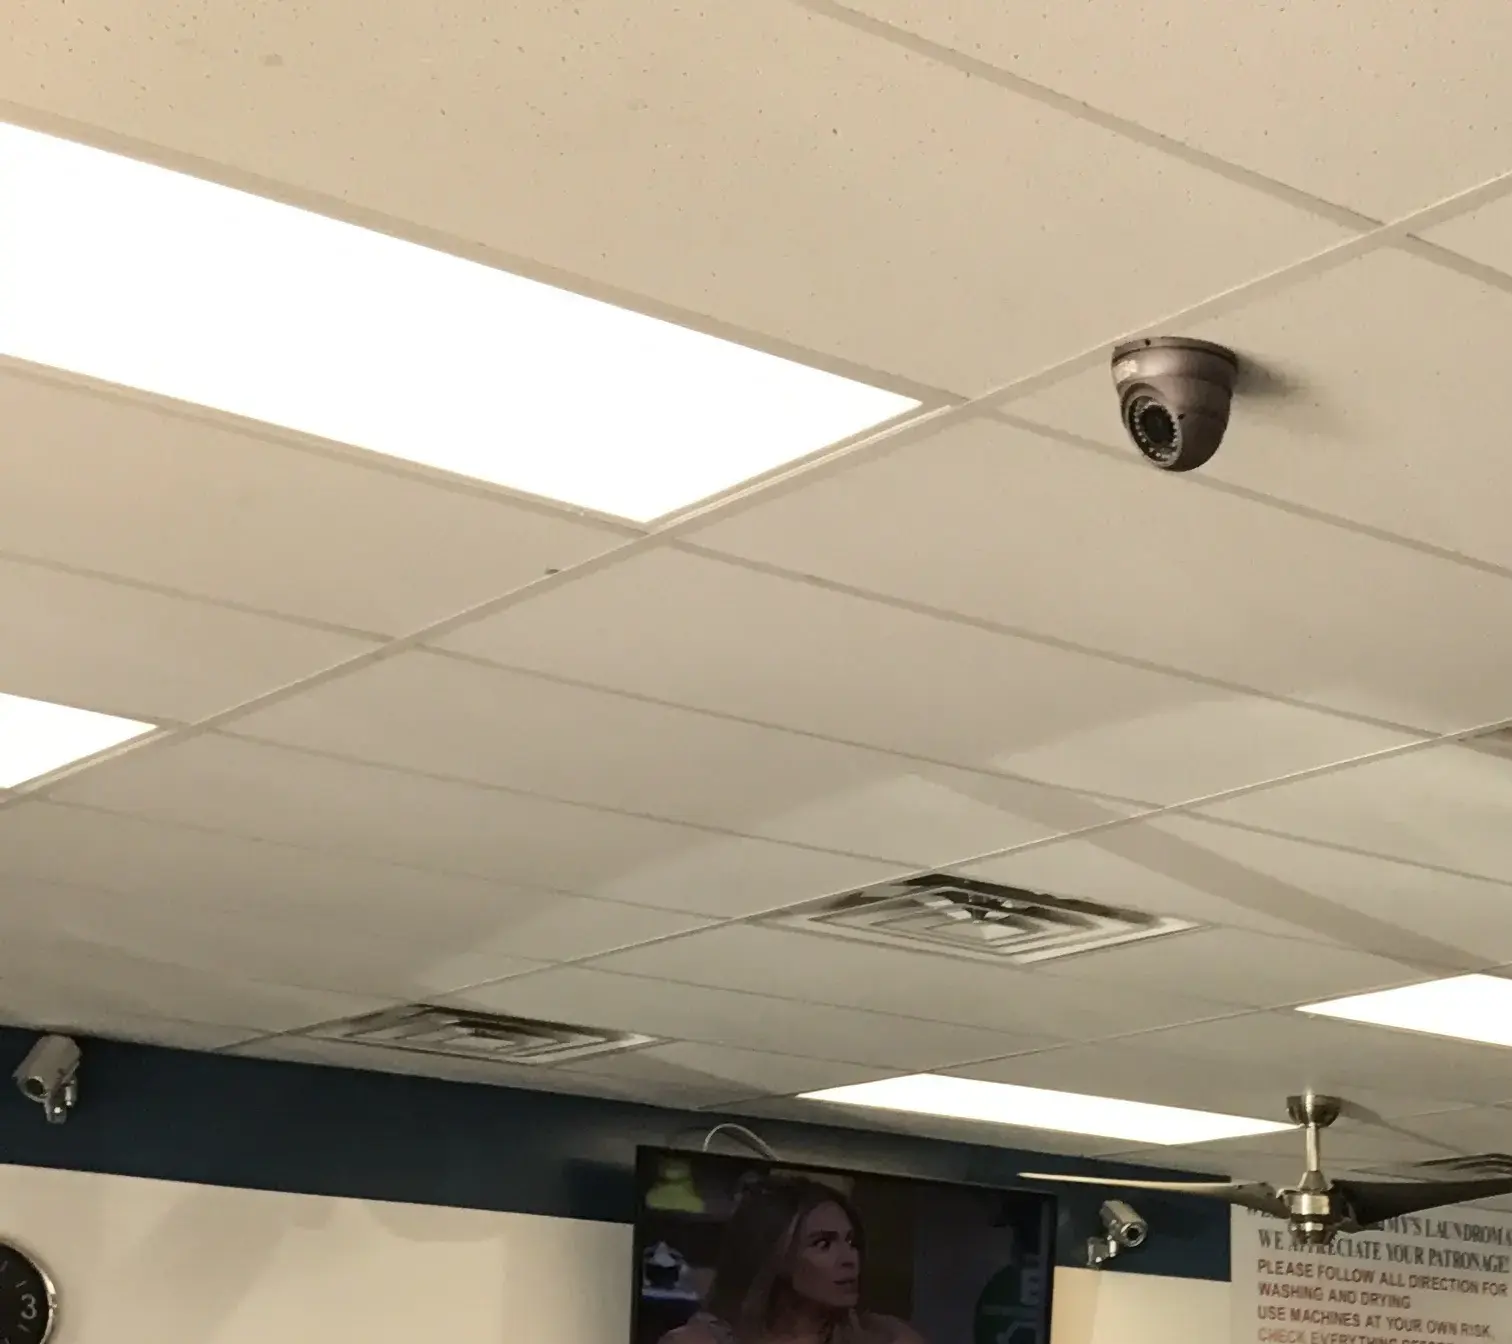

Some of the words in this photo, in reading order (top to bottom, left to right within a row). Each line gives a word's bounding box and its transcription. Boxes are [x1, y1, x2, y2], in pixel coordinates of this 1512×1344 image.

[1258, 1229, 1284, 1250] WE
[1386, 1243, 1424, 1265] YOUR
[1258, 1259, 1313, 1278] PLEASE
[1318, 1266, 1375, 1283] FOLLOW
[1379, 1272, 1405, 1288] ALL
[1409, 1274, 1478, 1294] DIRECTION
[1482, 1281, 1508, 1297] FOR
[21, 1293, 38, 1320] 3
[1258, 1282, 1323, 1301] WASHING
[1328, 1289, 1357, 1305] AND
[1361, 1292, 1411, 1310] DRYING
[1258, 1305, 1286, 1320] USE
[1290, 1307, 1360, 1327] MACHINES
[1365, 1315, 1381, 1328] AT
[1386, 1317, 1421, 1332] YOUR
[1426, 1320, 1457, 1335] OWN
